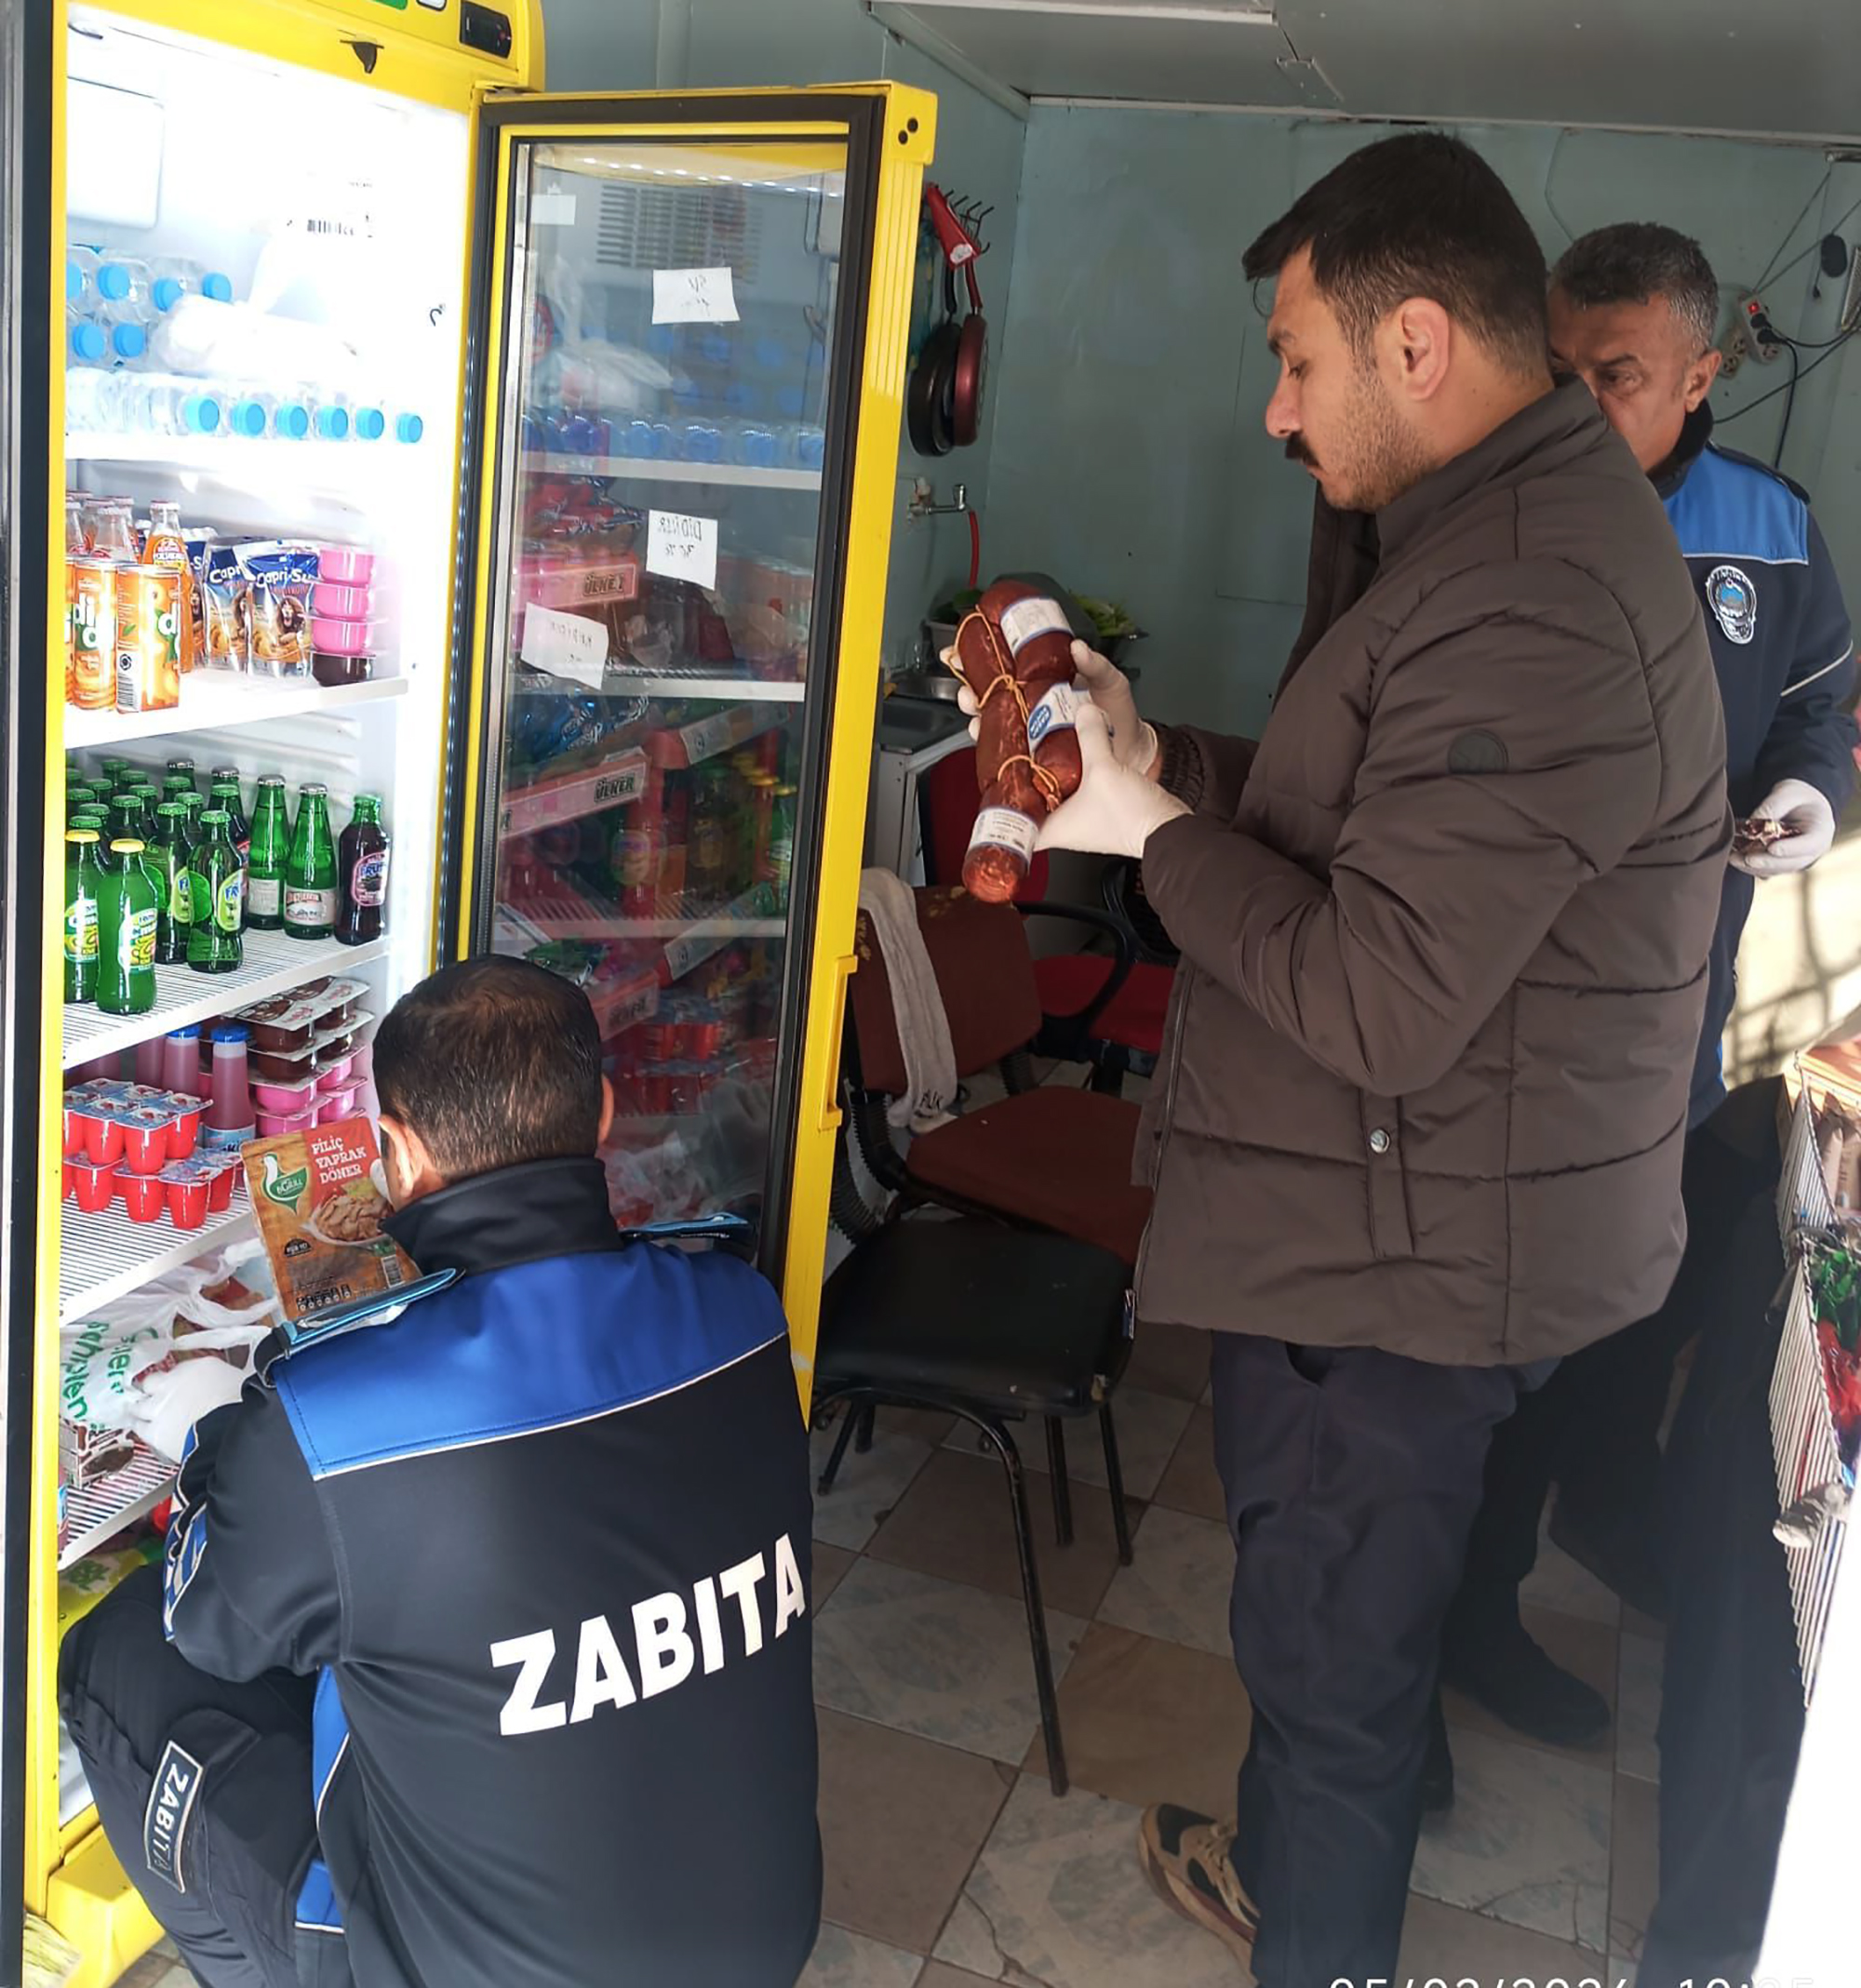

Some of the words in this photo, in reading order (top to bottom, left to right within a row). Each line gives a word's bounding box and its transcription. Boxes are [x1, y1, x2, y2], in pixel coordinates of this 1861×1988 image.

[256, 566, 312, 588] Capri-Su
[315, 1146, 368, 1168] YAPRAK
[319, 1164, 363, 1185] DÖNER
[489, 1532, 806, 1736] ZABITA
[153, 1763, 189, 1872] ZABITA
